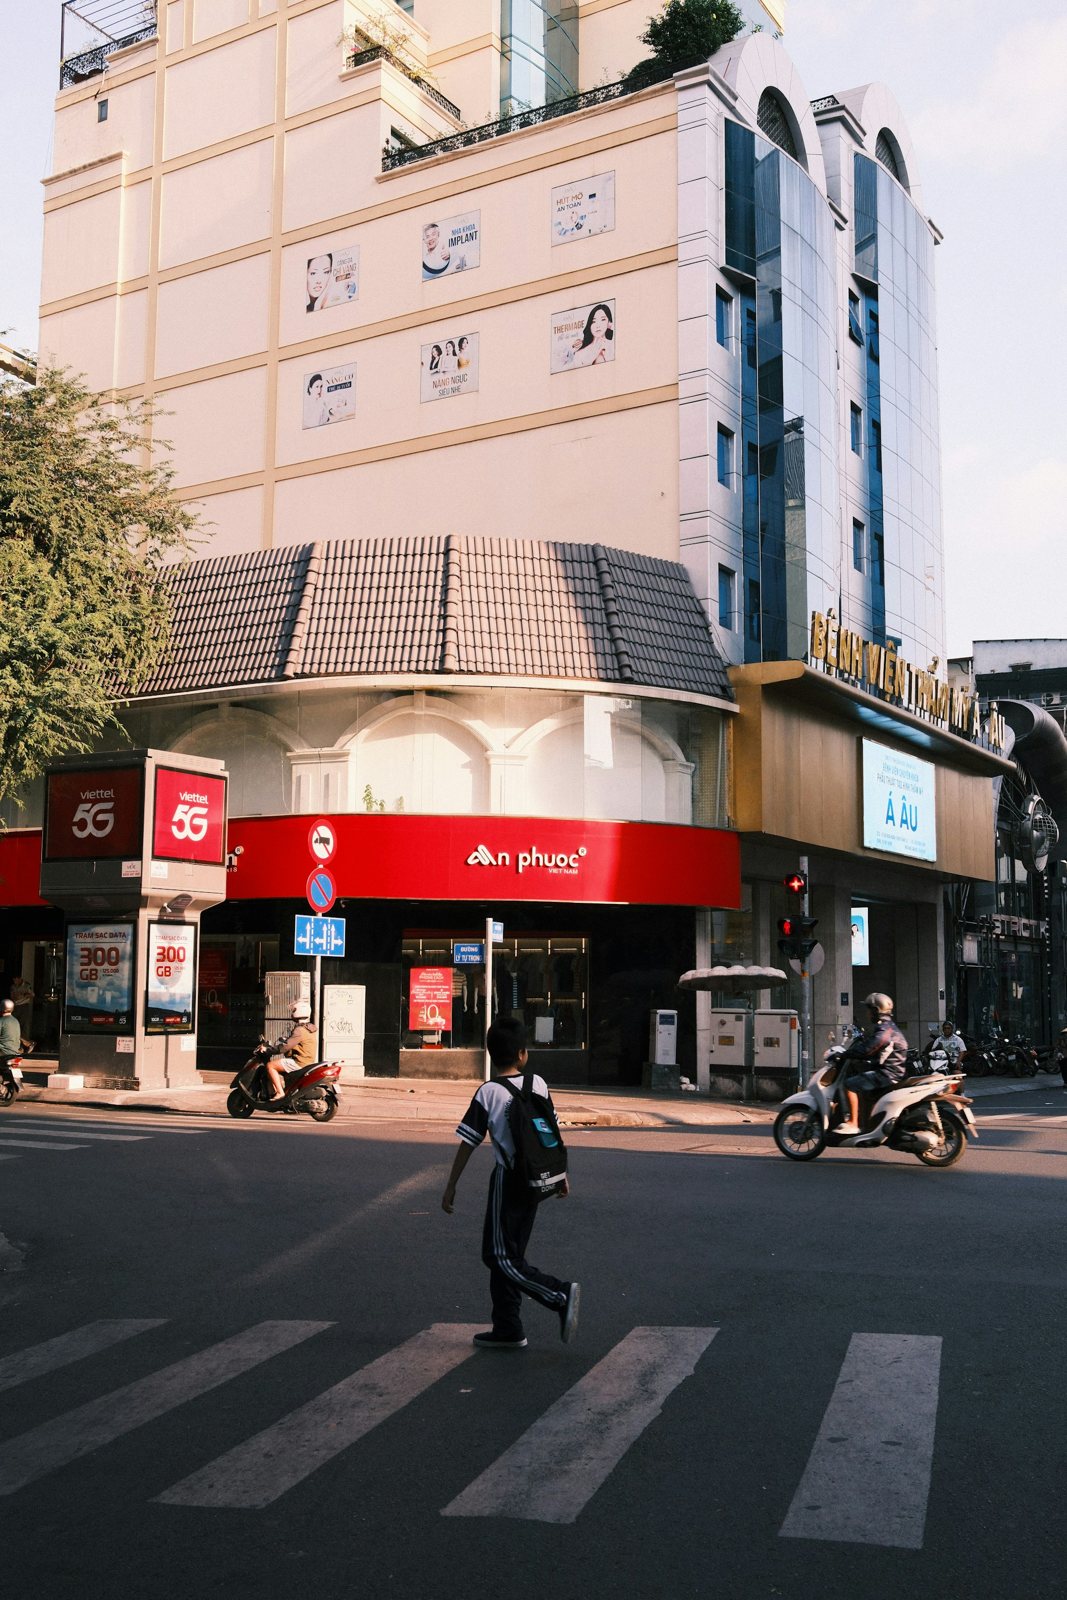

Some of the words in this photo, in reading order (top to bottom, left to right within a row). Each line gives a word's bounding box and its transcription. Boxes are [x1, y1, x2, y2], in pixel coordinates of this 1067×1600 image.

[448, 230, 478, 248] IMPLANT
[553, 319, 585, 334] THERMAGE
[811, 607, 863, 681] BỆNH
[866, 640, 907, 703] VIỆN
[989, 701, 1006, 752] ÂU
[80, 788, 116, 800] viettel
[178, 791, 209, 804] viettel
[71, 801, 115, 839] 5G
[885, 791, 896, 827] Á
[899, 794, 918, 832] ÂU
[171, 803, 209, 842] 5G
[79, 947, 120, 967] 300
[156, 945, 186, 963] 300
[79, 968, 99, 981] GB
[156, 965, 172, 978] GB
